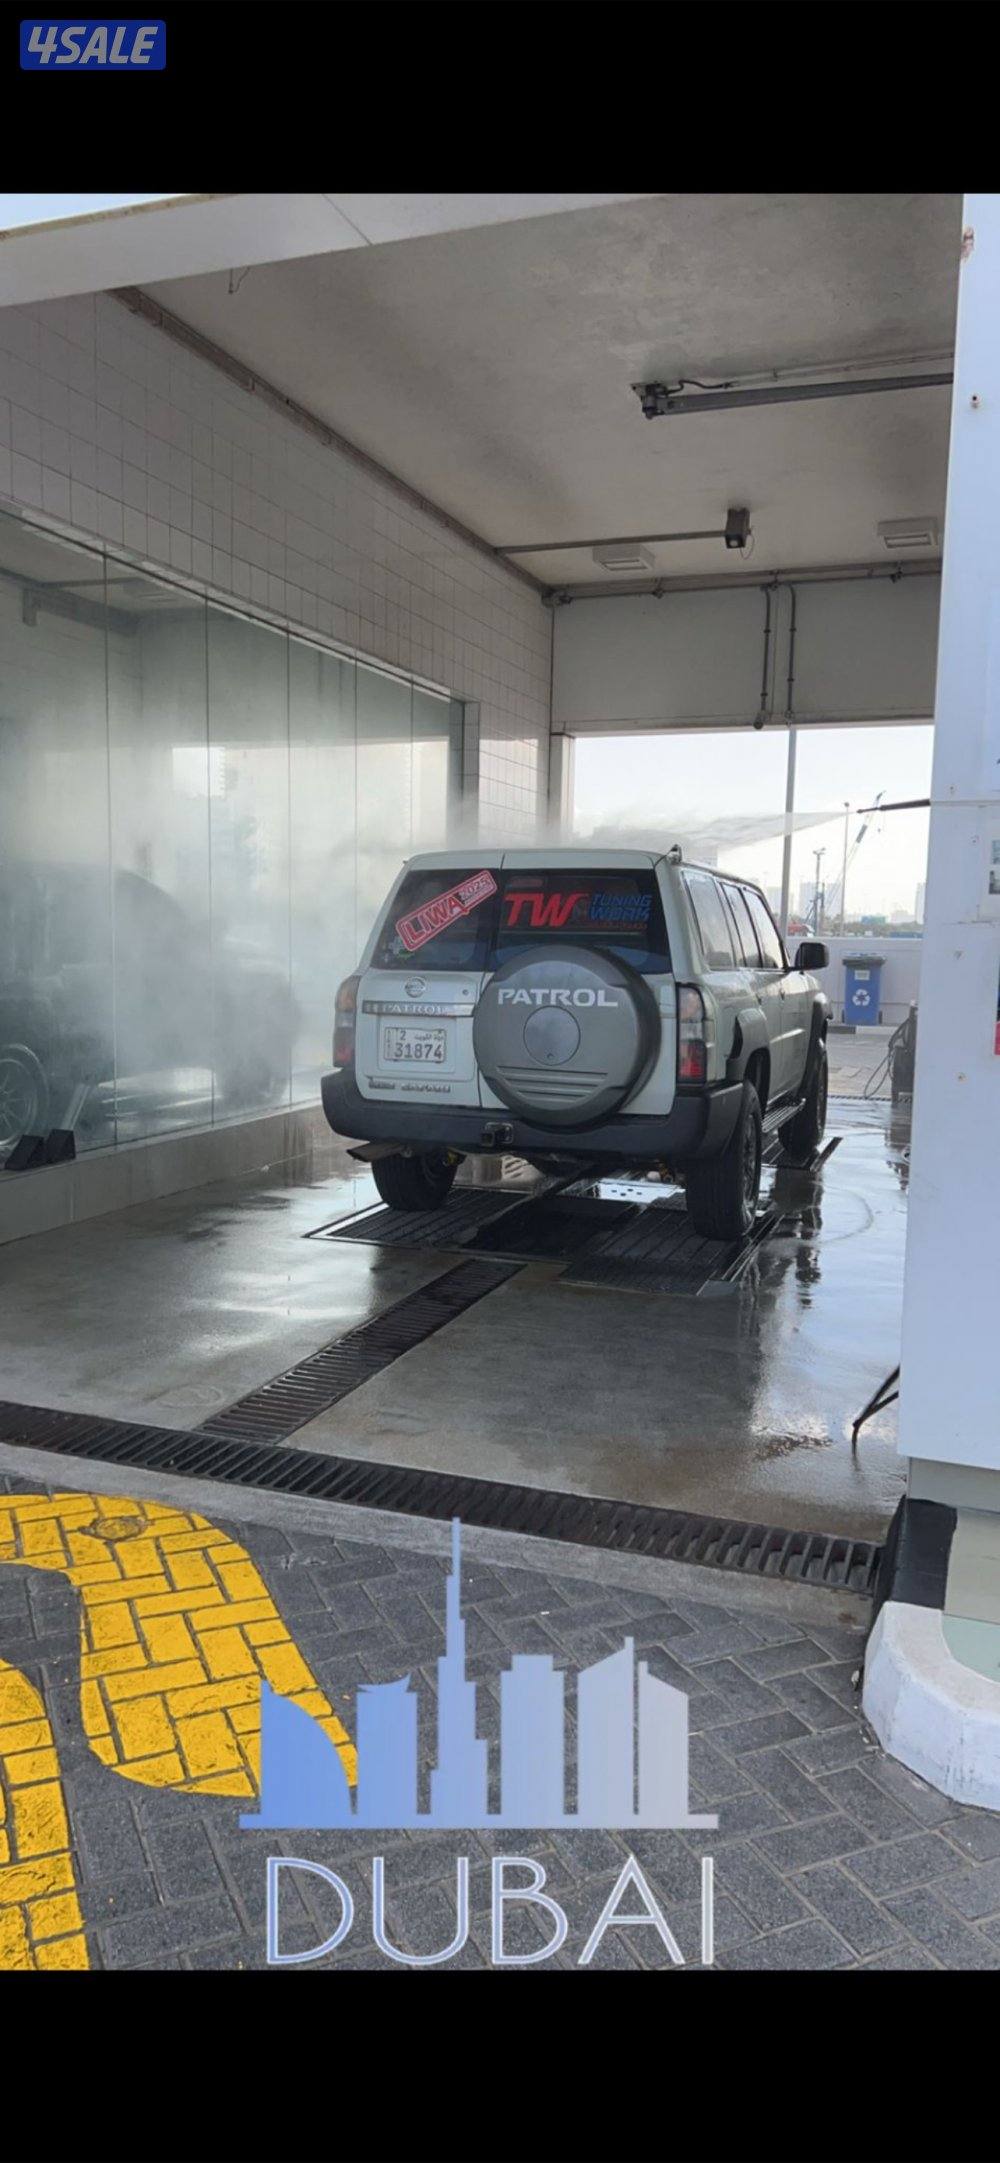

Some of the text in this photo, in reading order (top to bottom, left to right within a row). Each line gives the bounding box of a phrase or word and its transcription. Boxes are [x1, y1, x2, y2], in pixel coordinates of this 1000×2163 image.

[592, 893, 653, 907] TUNING
[504, 891, 588, 928] TW
[590, 906, 651, 922] WORK
[404, 895, 465, 945] LIWA
[497, 987, 619, 1008] PATROL
[400, 1030, 407, 1041] 2
[394, 1042, 442, 1060] 31874
